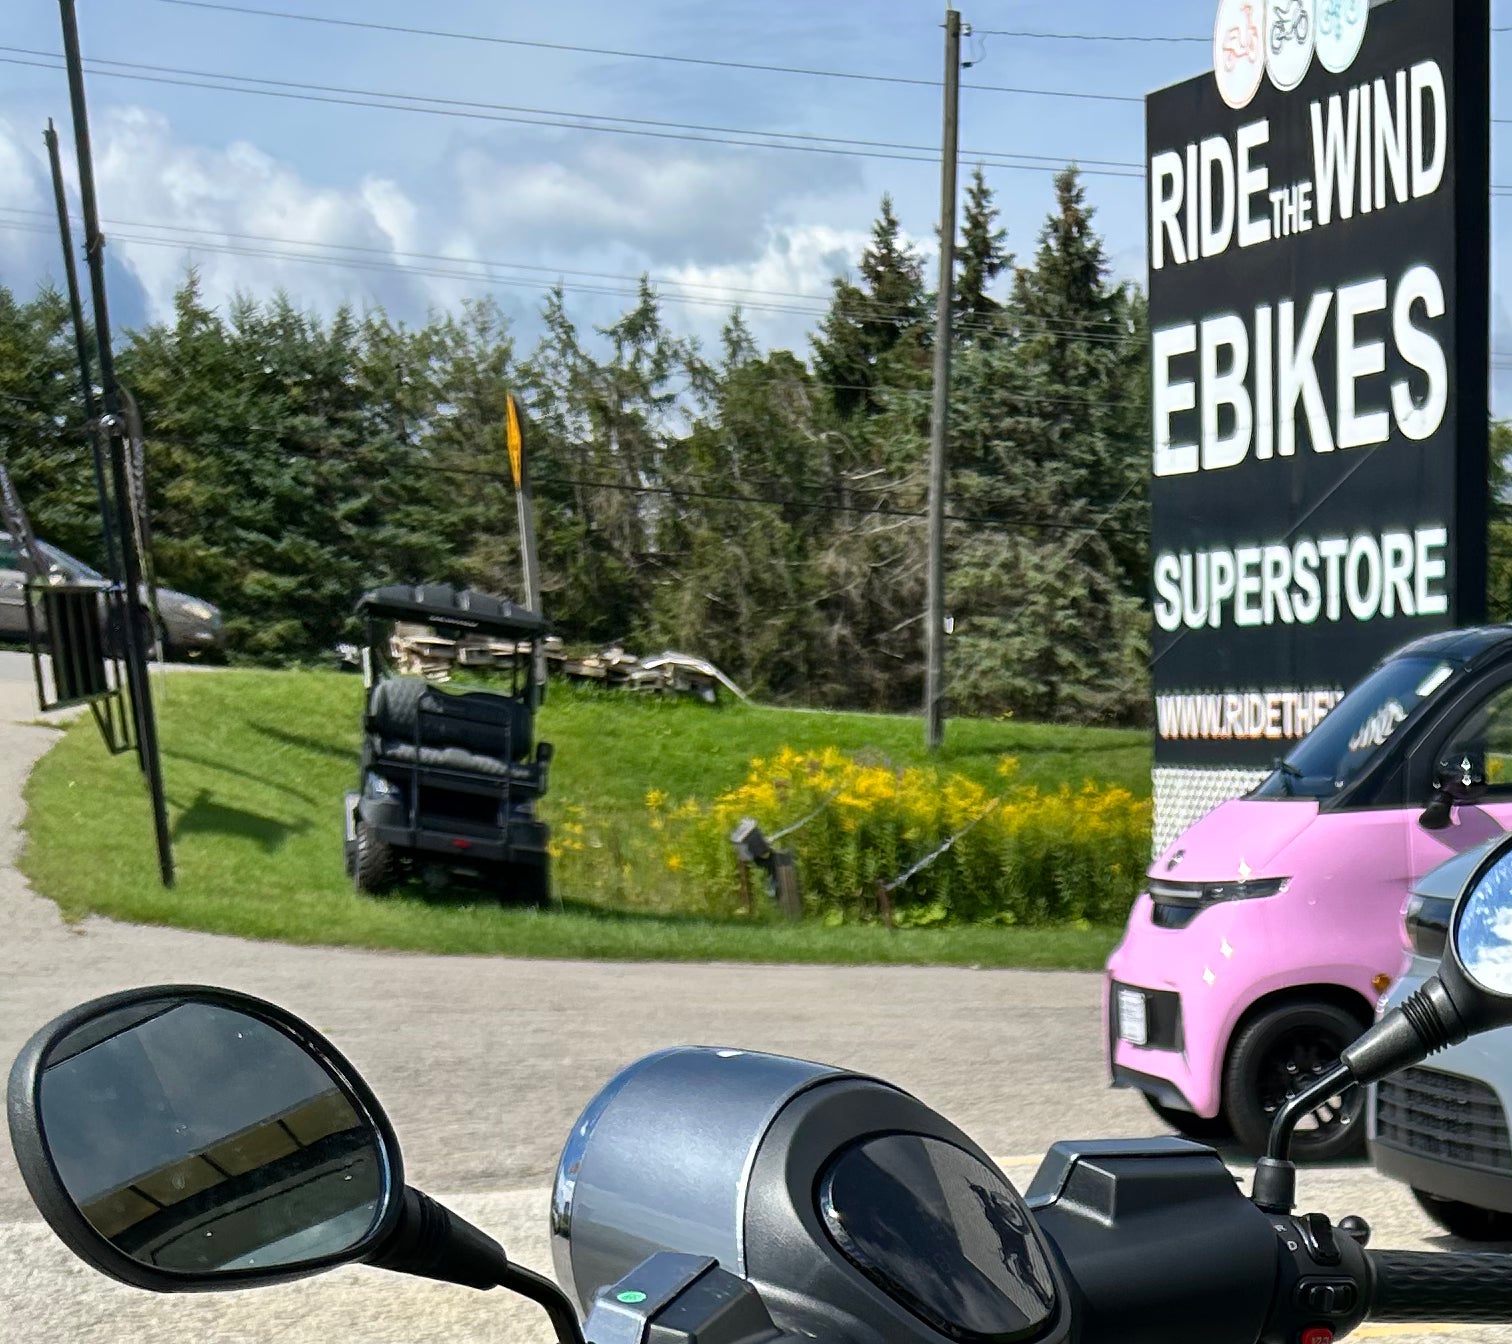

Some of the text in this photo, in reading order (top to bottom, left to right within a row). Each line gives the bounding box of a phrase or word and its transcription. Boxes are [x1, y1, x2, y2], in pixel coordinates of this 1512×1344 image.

[1151, 60, 1448, 270] RIDE THE WIND
[1152, 265, 1447, 477] EBIKES
[1153, 527, 1449, 633] SUPERSTORE
